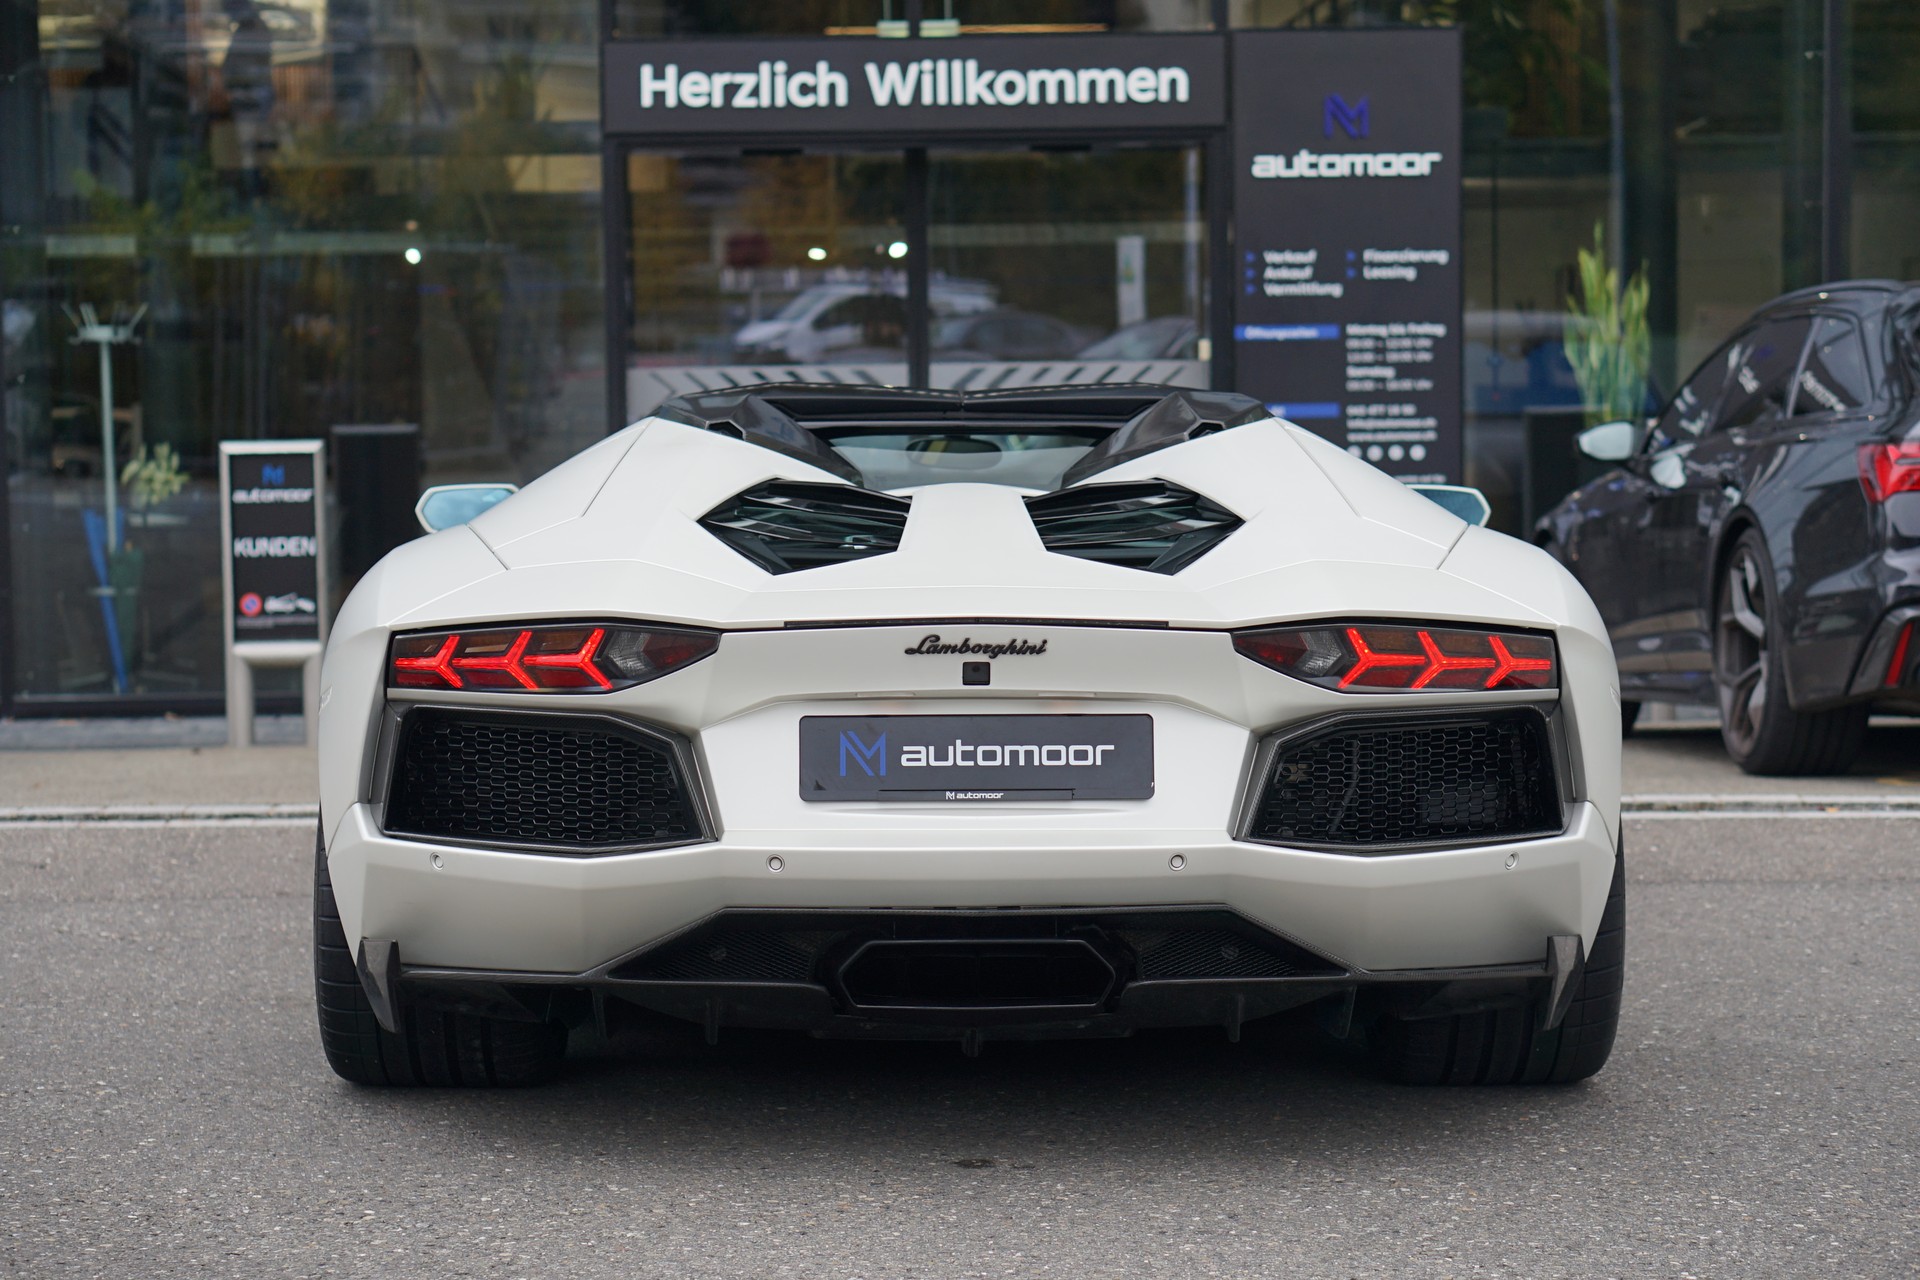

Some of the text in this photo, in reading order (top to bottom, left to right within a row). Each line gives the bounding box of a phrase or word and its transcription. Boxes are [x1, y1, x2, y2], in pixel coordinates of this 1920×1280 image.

[640, 59, 1190, 108] Herzlich Willkommen
[1251, 149, 1443, 178] automoor
[1263, 248, 1317, 264] Verkauf
[1363, 248, 1449, 265] Finanzierung
[1263, 265, 1314, 280] Ankauf
[1363, 265, 1417, 282] Leasing
[1263, 281, 1344, 298] Vermittlung
[233, 536, 317, 558] KUNDEN
[904, 634, 1047, 659] Lamborghini
[901, 739, 1115, 767] automoor
[956, 791, 1005, 799] automoor
